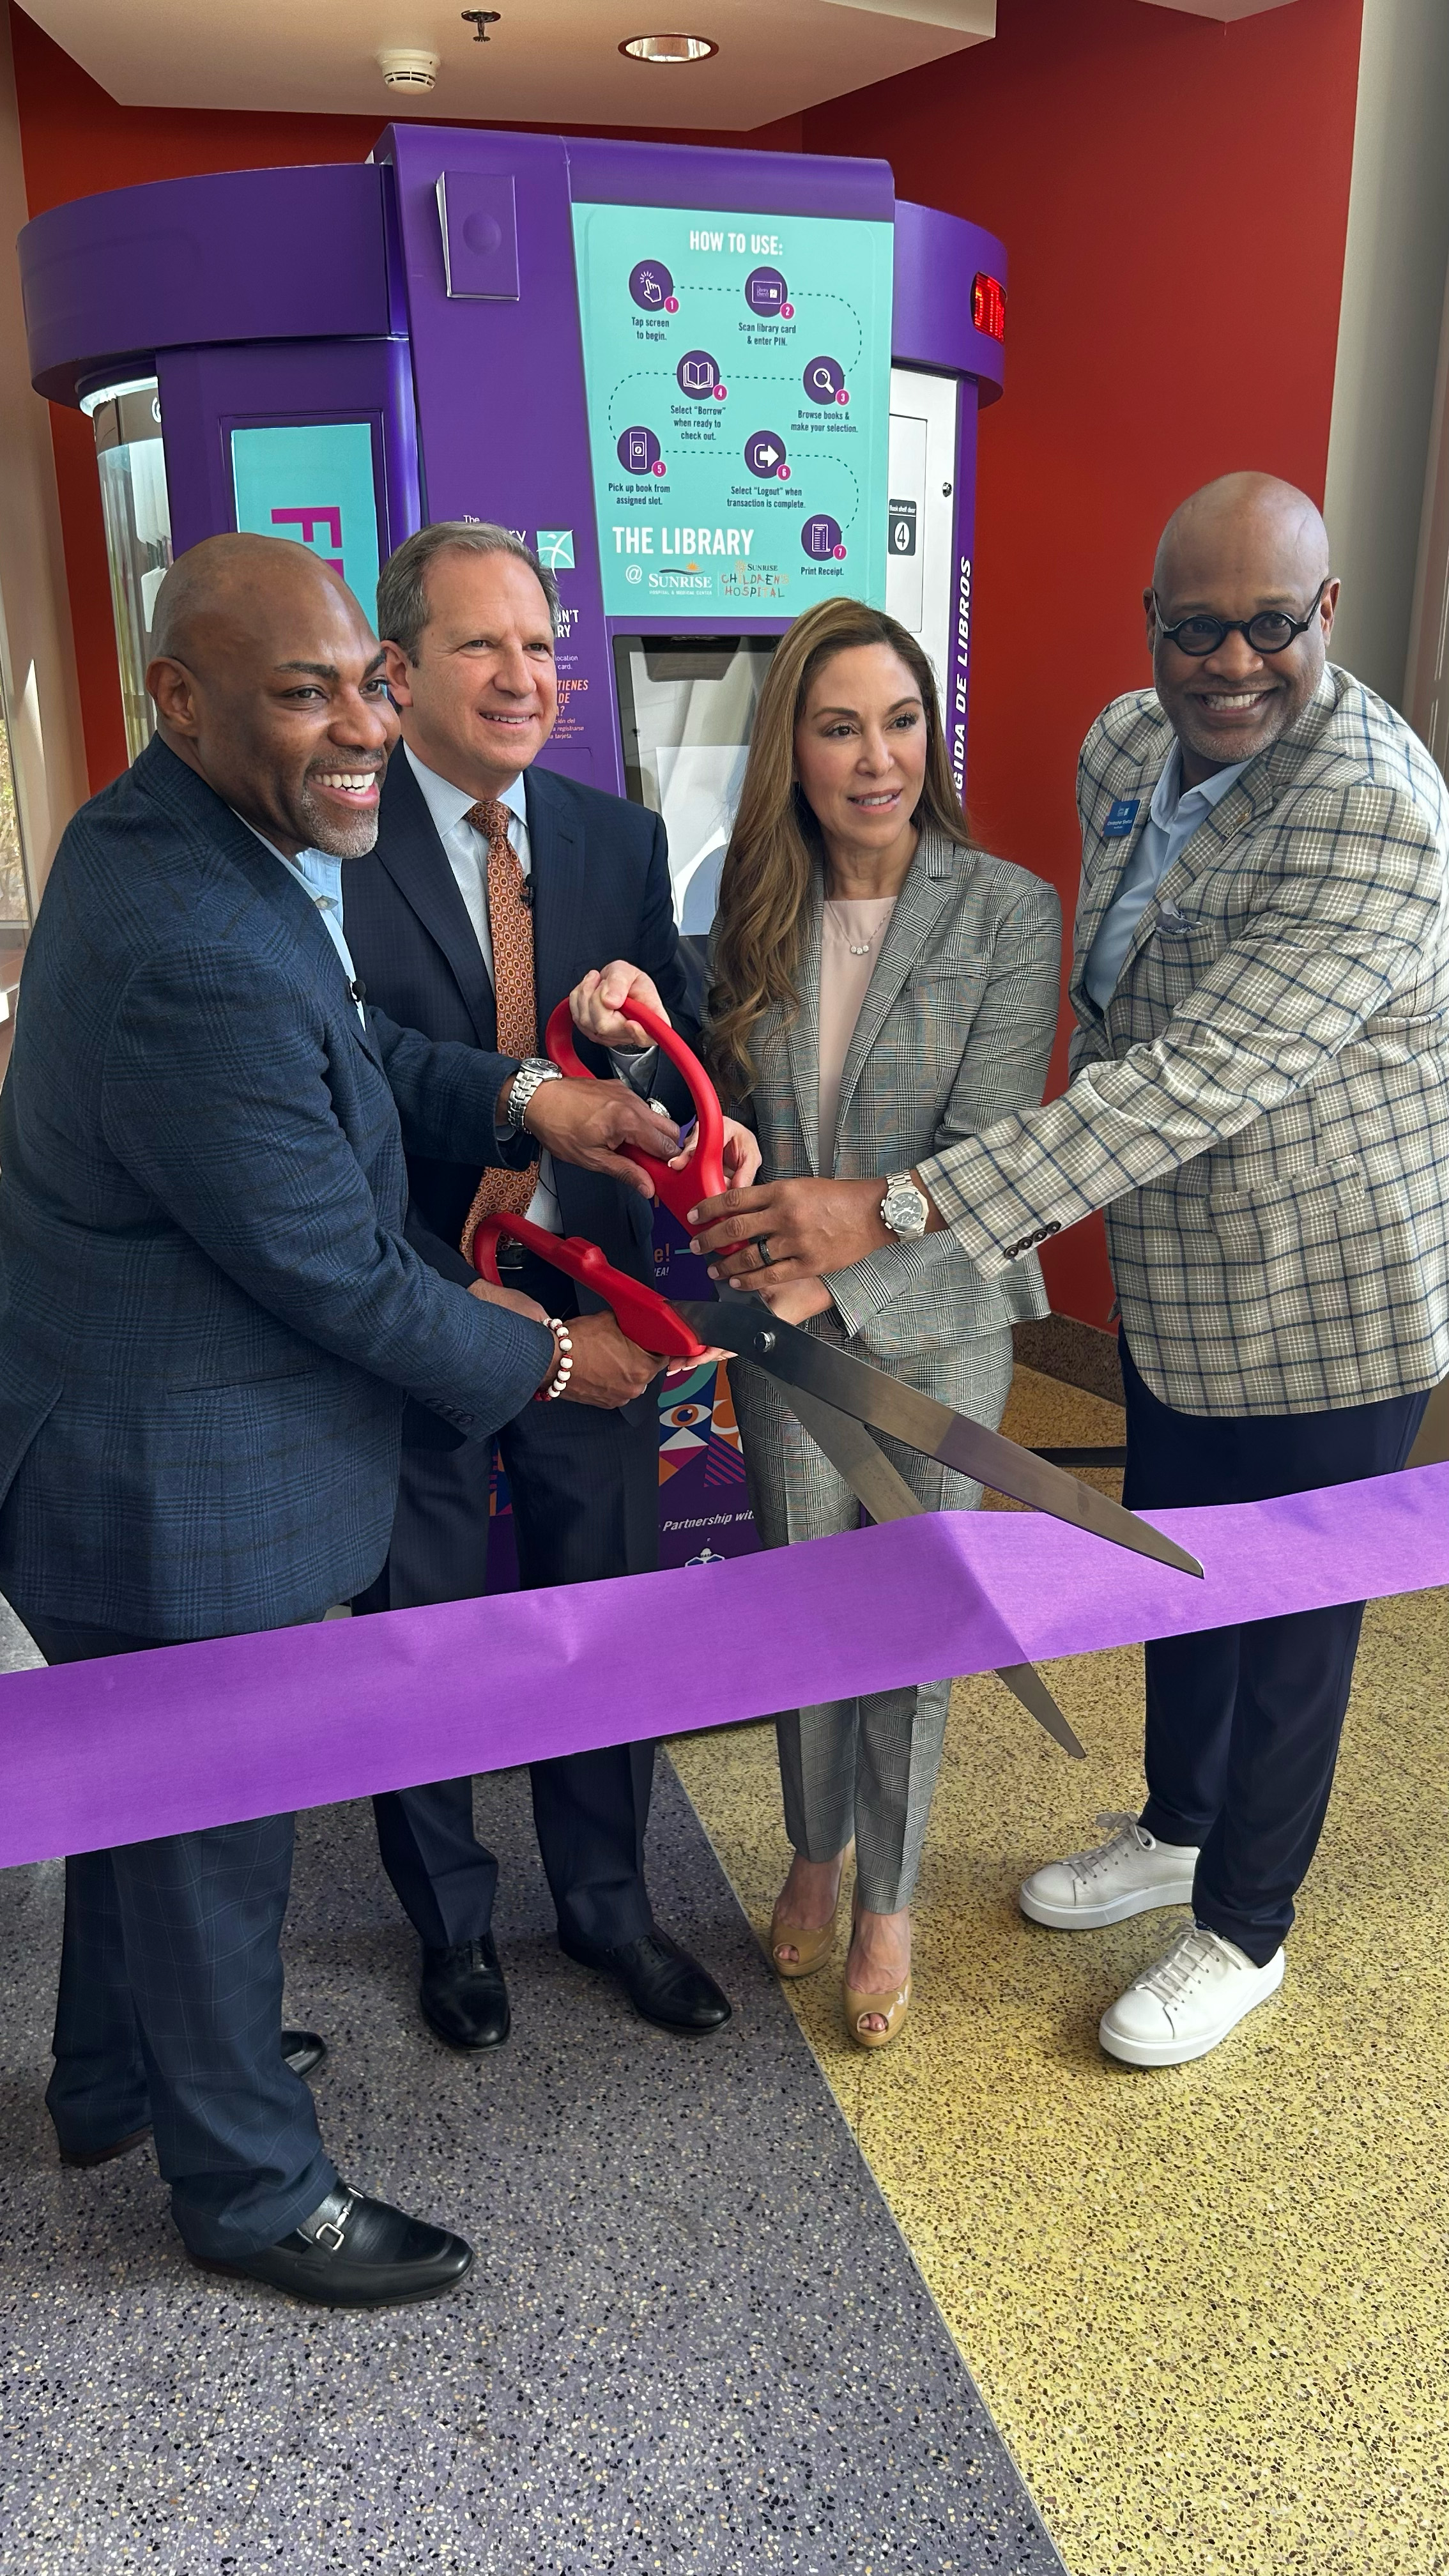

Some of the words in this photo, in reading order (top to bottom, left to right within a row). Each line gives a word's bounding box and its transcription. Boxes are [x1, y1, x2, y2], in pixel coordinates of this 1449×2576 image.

[690, 231, 723, 251] HOW
[728, 233, 746, 253] TO
[751, 234, 783, 255] USE:
[670, 301, 674, 310] 1
[785, 307, 790, 316] 2
[631, 317, 643, 328] Tap
[645, 319, 669, 328] screen
[739, 323, 755, 332] Scan
[757, 324, 779, 334] library
[781, 325, 796, 334] card
[636, 330, 644, 339] to
[645, 330, 667, 342] begin.
[747, 336, 752, 344] &
[754, 337, 772, 346] enter
[774, 337, 788, 346] PIN.
[717, 388, 723, 397] 4
[840, 394, 845, 402] 3
[671, 405, 692, 414] Select
[798, 410, 822, 419] Browse
[824, 411, 843, 420] books
[845, 412, 850, 420] &
[673, 418, 691, 427] when
[693, 418, 712, 429] ready
[714, 420, 721, 428] to
[791, 423, 808, 432] make
[810, 425, 825, 434] your
[827, 424, 858, 433] selection.
[681, 432, 702, 440] check
[703, 433, 716, 441] out.
[657, 465, 662, 473] 5
[782, 468, 786, 477] 6
[608, 483, 624, 492] Pick
[625, 486, 634, 494] up
[636, 485, 652, 493] book
[654, 485, 670, 493] from
[731, 486, 752, 494] Select
[785, 487, 802, 496] when
[617, 496, 647, 506] assigned
[648, 497, 663, 505] slot.
[727, 498, 765, 507] transaction
[767, 500, 772, 508] is
[774, 500, 806, 510] complete.
[463, 514, 480, 523] The
[613, 527, 654, 555] THE
[662, 528, 754, 555] LIBRARY
[897, 525, 905, 548] 4
[838, 548, 843, 556] 7
[625, 565, 643, 584] @
[801, 567, 816, 576] Print
[818, 567, 844, 576] Receipt.
[649, 574, 712, 588] SUNRISE
[724, 586, 785, 598] HOSPITAL
[958, 556, 970, 667] LIBROS
[558, 680, 588, 691] TIENES
[558, 693, 571, 703] DE
[956, 673, 967, 714] DE
[663, 1512, 732, 1531] Partnership
